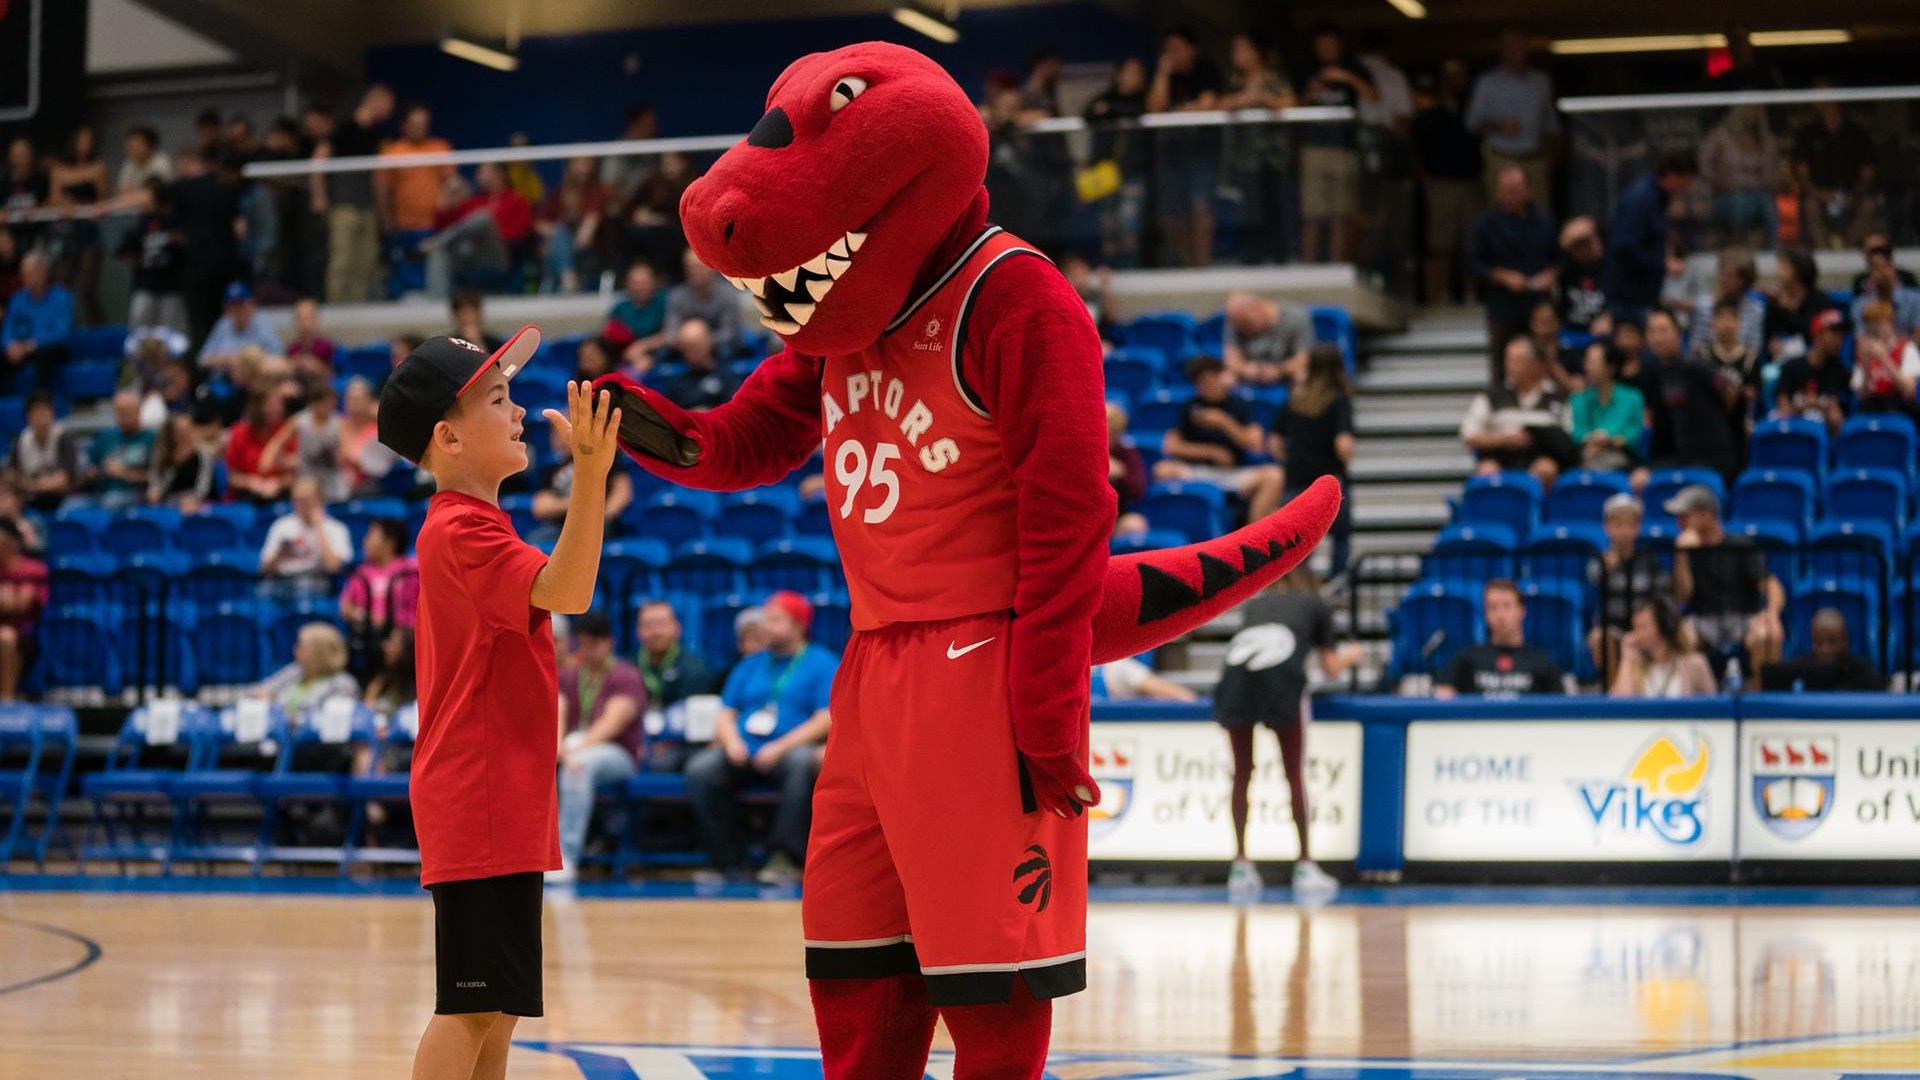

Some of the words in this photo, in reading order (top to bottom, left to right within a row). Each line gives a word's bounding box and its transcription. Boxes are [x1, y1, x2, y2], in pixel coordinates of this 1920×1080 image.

[912, 341, 928, 350] Sun
[929, 342, 943, 352] Life
[822, 369, 960, 473] APTORS
[835, 439, 900, 524] 95
[1433, 755, 1535, 782] HOME
[1153, 794, 1189, 824] of
[1424, 798, 1466, 826] OF
[1479, 798, 1538, 826] THE
[1580, 784, 1703, 845] Vikes
[1857, 790, 1894, 822] of
